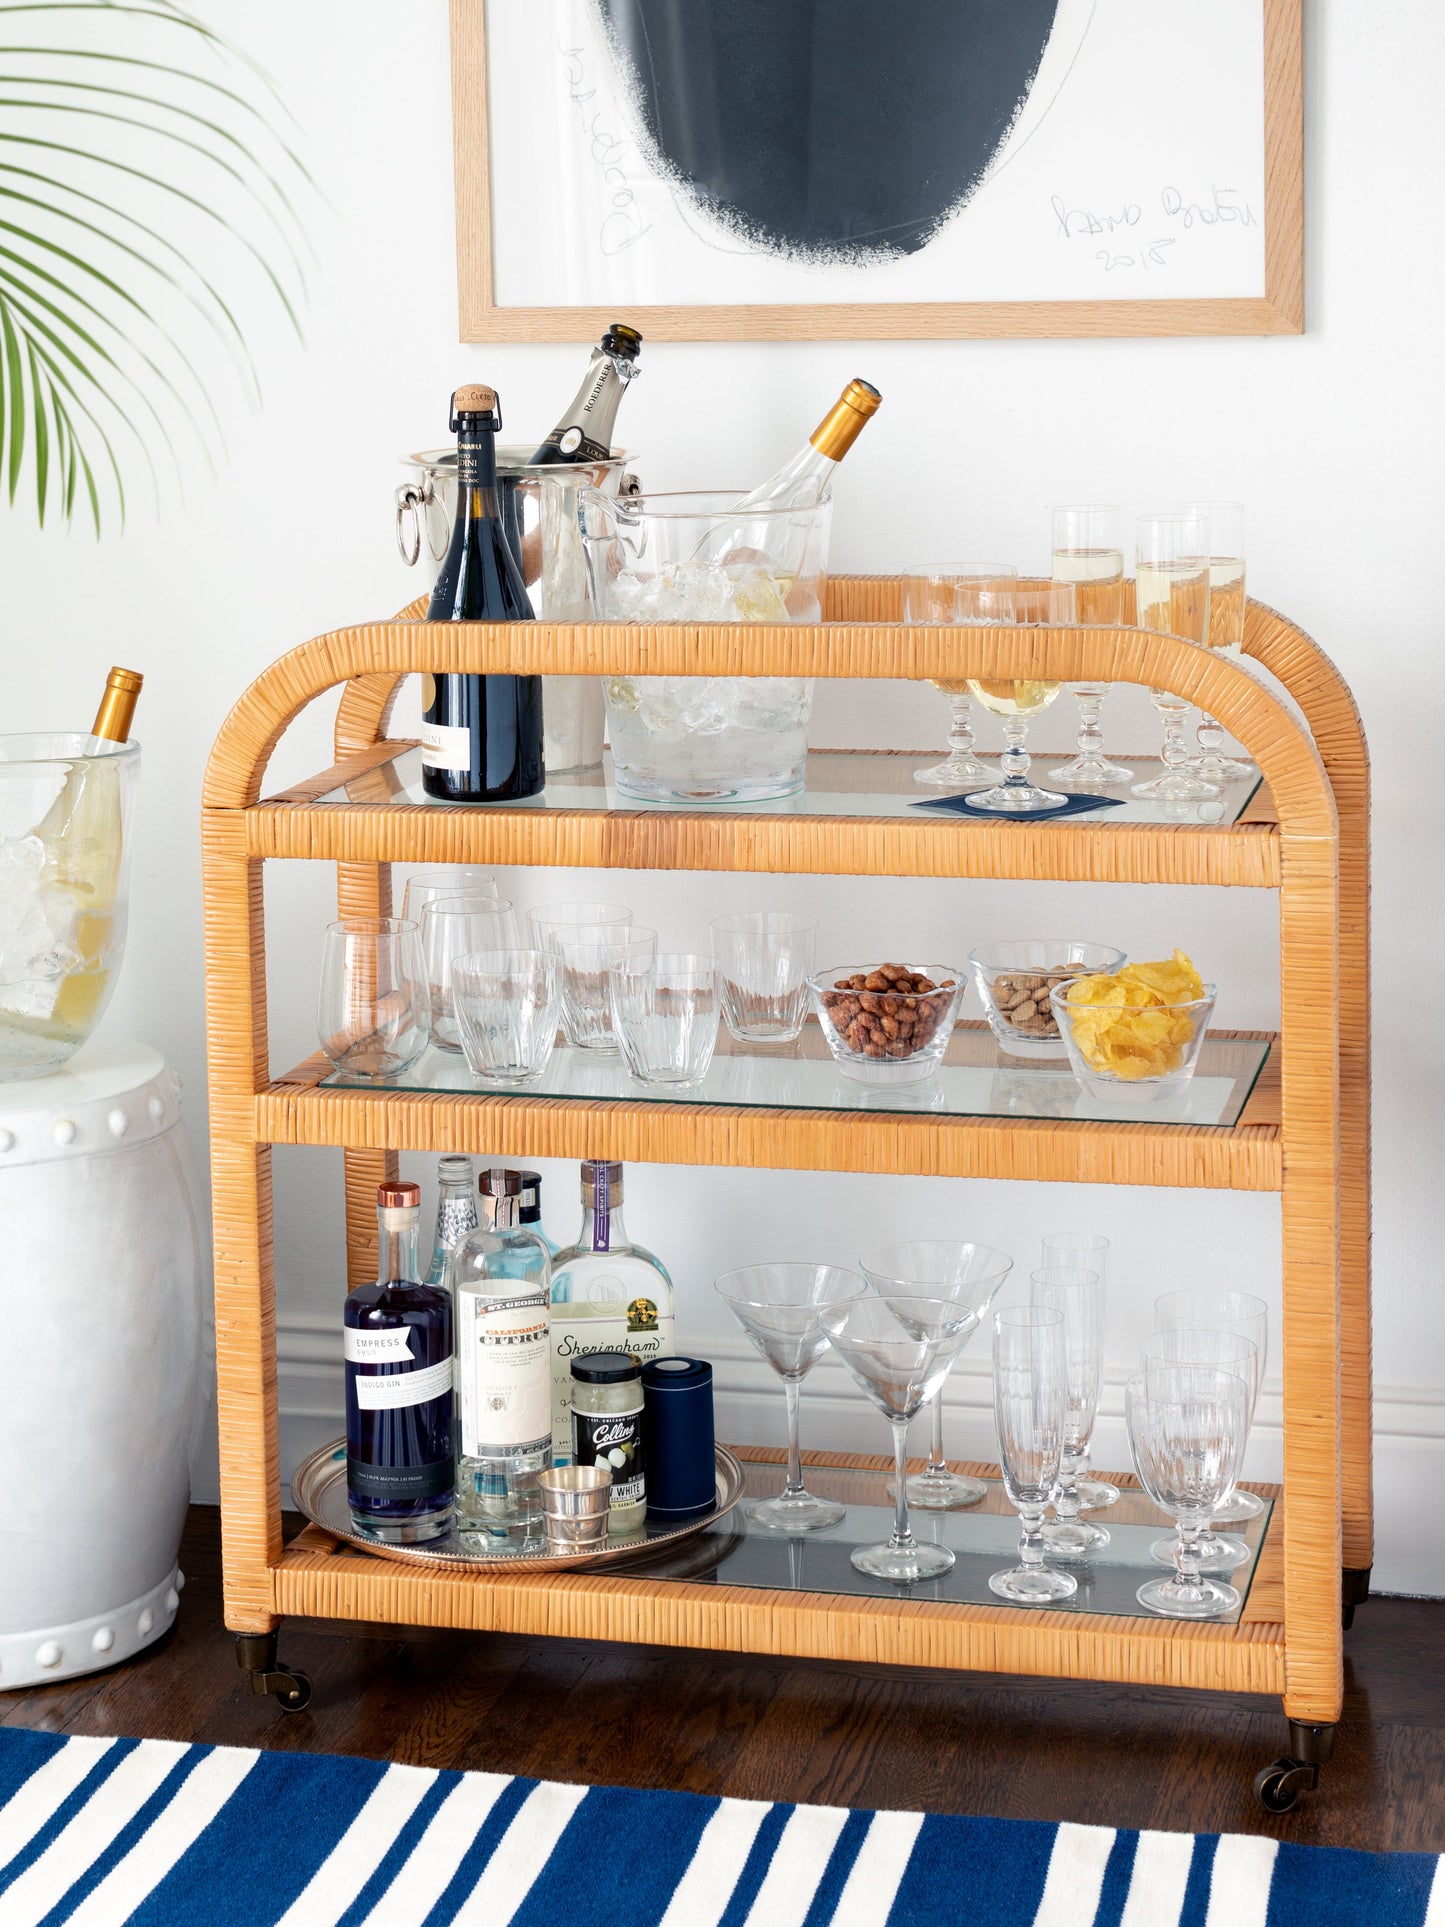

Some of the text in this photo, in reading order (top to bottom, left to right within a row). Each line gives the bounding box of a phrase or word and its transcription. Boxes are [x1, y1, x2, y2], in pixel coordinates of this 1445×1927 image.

[584, 364, 612, 412] ROEDERER
[506, 1299, 545, 1308] GEORGE
[485, 1322, 547, 1335] CALIFORNIA
[356, 1338, 400, 1348] EMPRESS
[479, 1329, 549, 1345] CITRUS
[592, 1422, 635, 1445] Collins
[618, 1482, 640, 1496] WHITE
